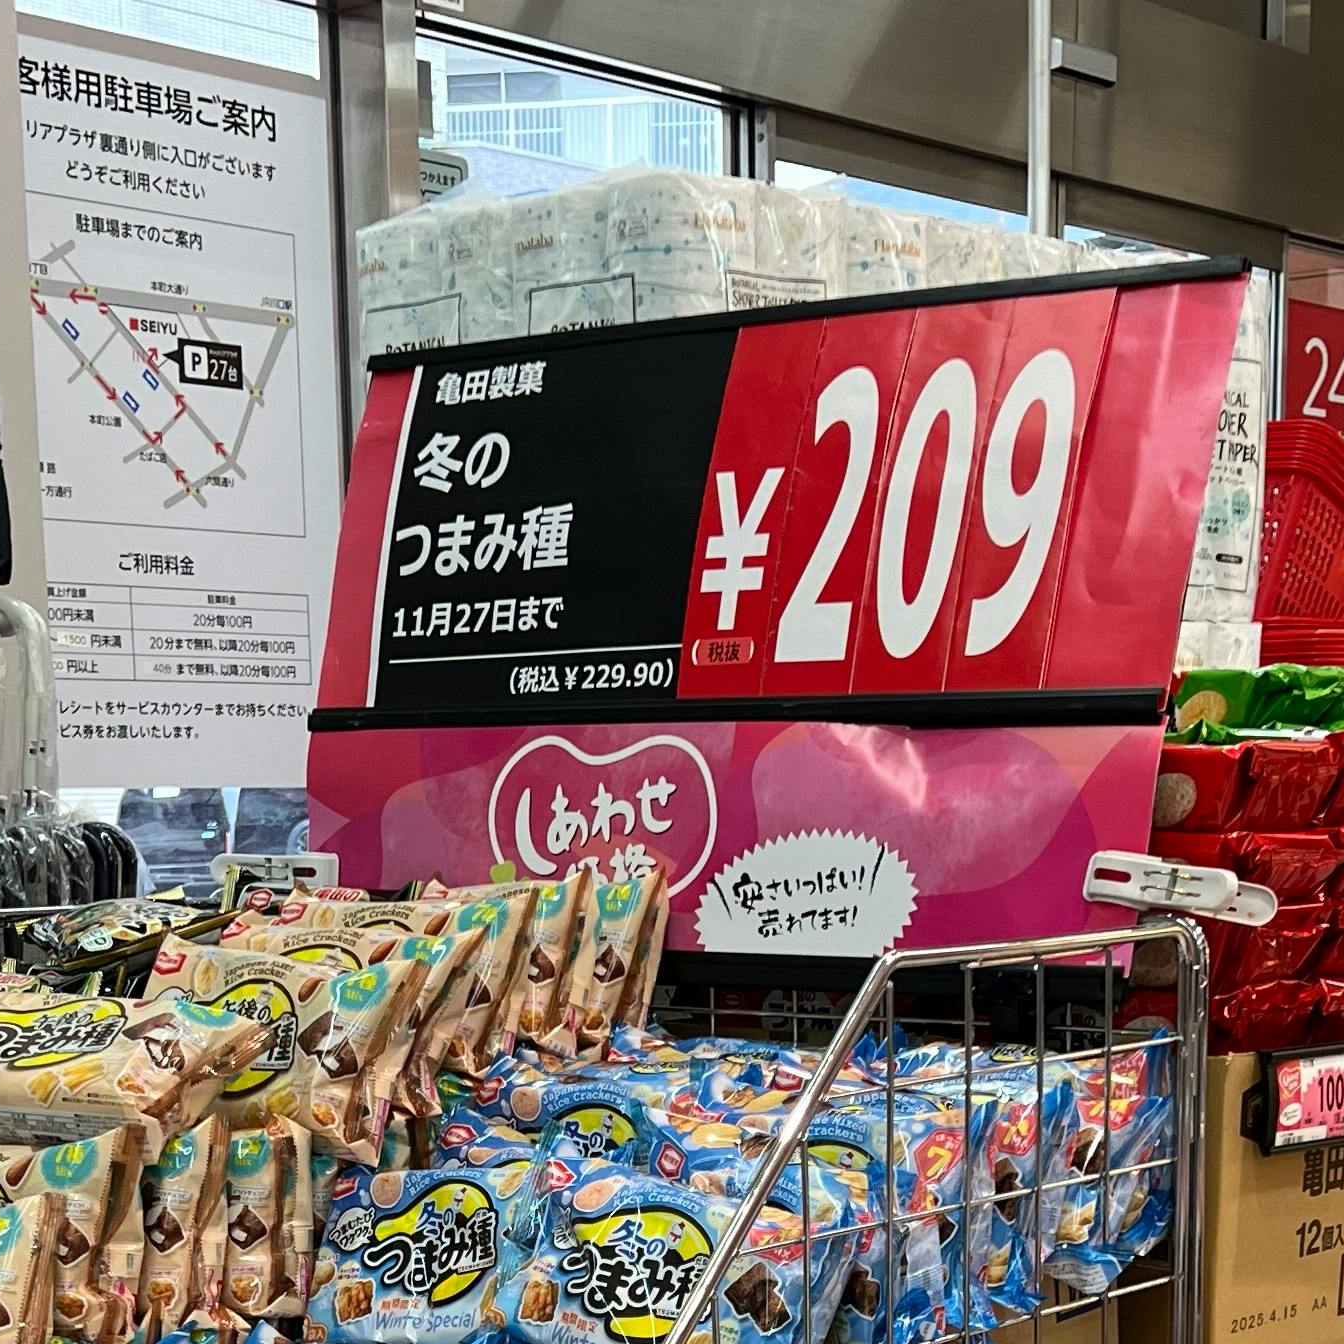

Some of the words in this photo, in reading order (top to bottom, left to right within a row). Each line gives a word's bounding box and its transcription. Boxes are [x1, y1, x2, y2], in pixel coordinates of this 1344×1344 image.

[18, 56, 277, 142] 客様用駐車場ご案内
[65, 159, 206, 200] どうぞご利用ください
[75, 213, 203, 251] 駐車場までのご案内
[140, 319, 178, 336] SEIYU
[191, 355, 203, 372] P
[435, 360, 548, 405] 亀田製菓
[414, 432, 510, 493] 冬の
[395, 502, 574, 577] つまみ種
[119, 553, 195, 576] ご利用料金
[392, 596, 565, 637] 11月27日まで
[515, 775, 677, 876] しあわせ
[1317, 1073, 1344, 1113] 100
[420, 1200, 455, 1237] 冬の
[1296, 1218, 1344, 1258] 12個入
[365, 1213, 497, 1292] つまみ種
[424, 1311, 476, 1332] Special
[1230, 1305, 1298, 1334] 2025.4.15
[1312, 1296, 1328, 1311] AA
